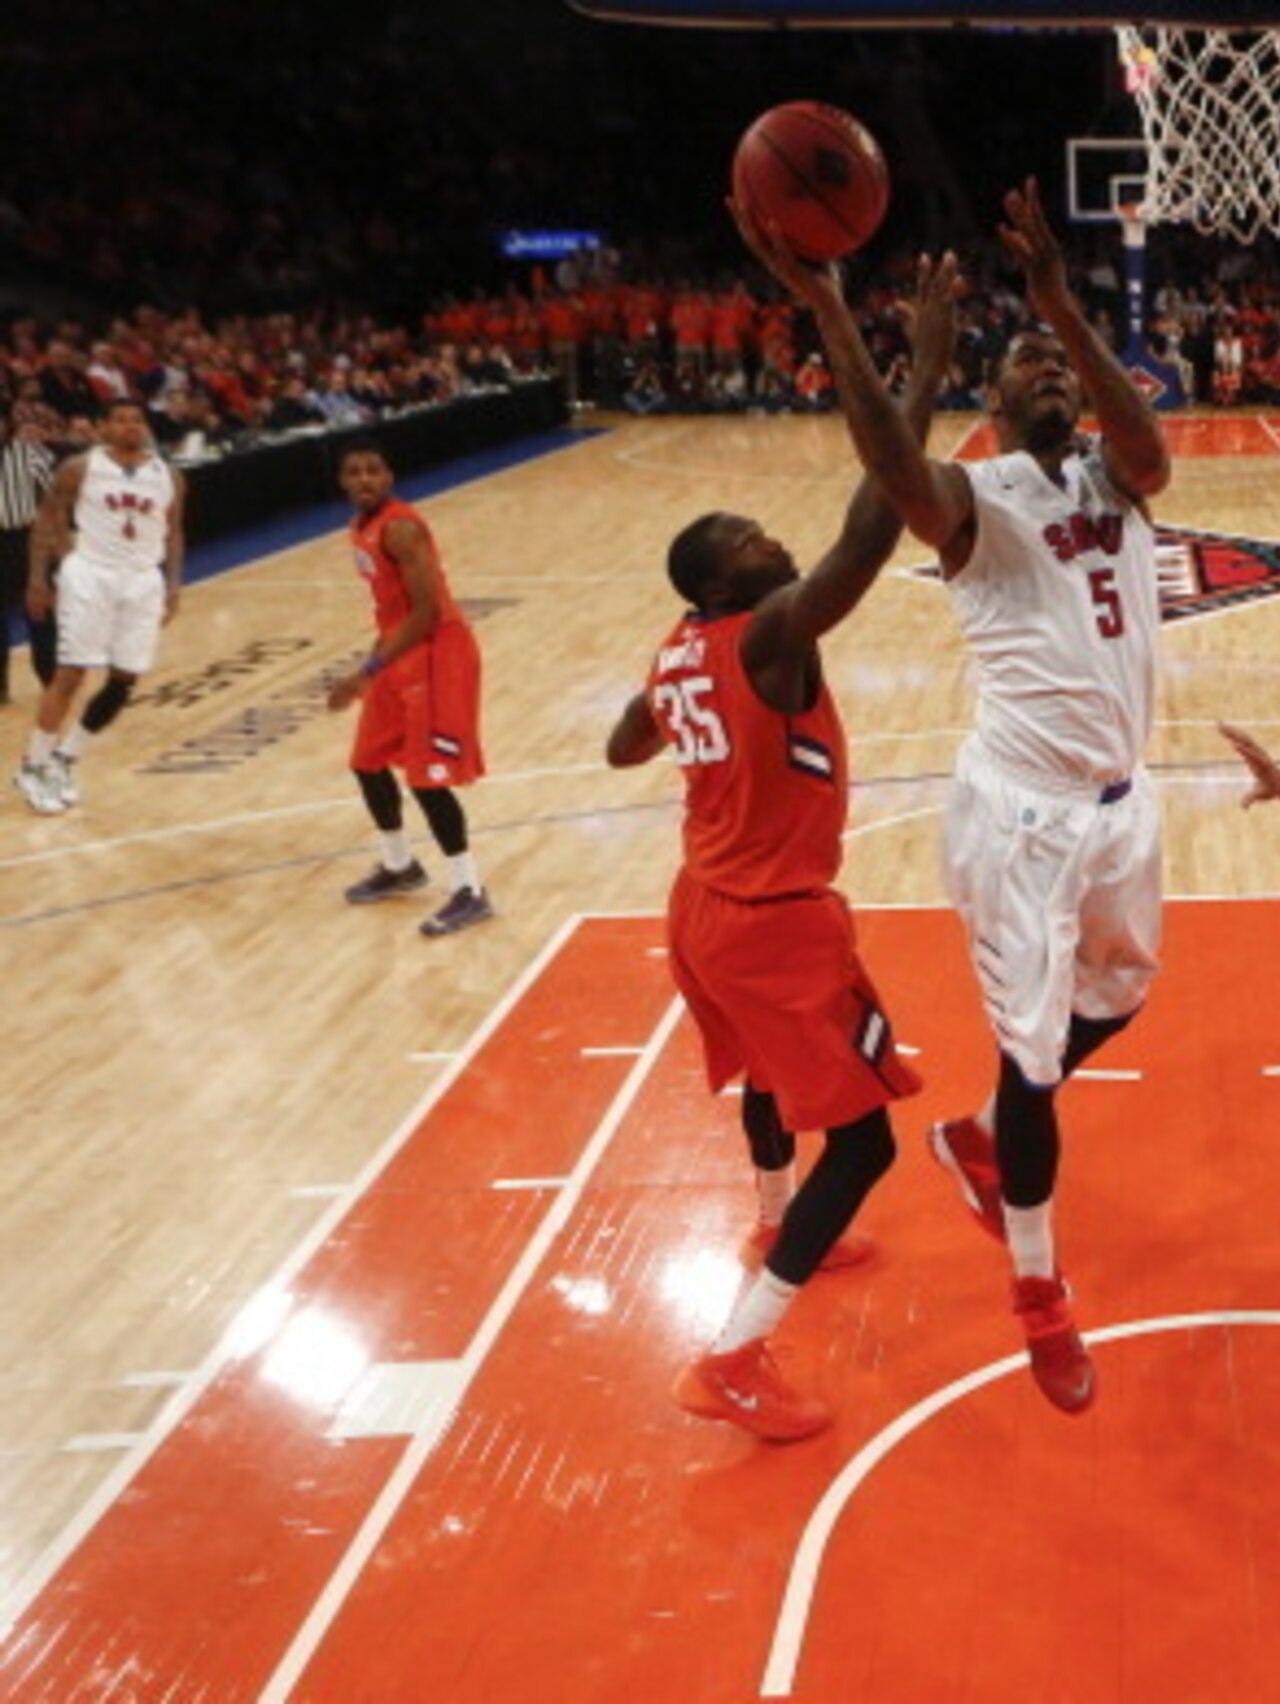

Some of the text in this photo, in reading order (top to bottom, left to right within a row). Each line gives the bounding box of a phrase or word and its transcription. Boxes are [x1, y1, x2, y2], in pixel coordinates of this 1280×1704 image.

[1043, 510, 1124, 564] SMU
[1087, 566, 1125, 640] 5
[653, 675, 732, 767] 35
